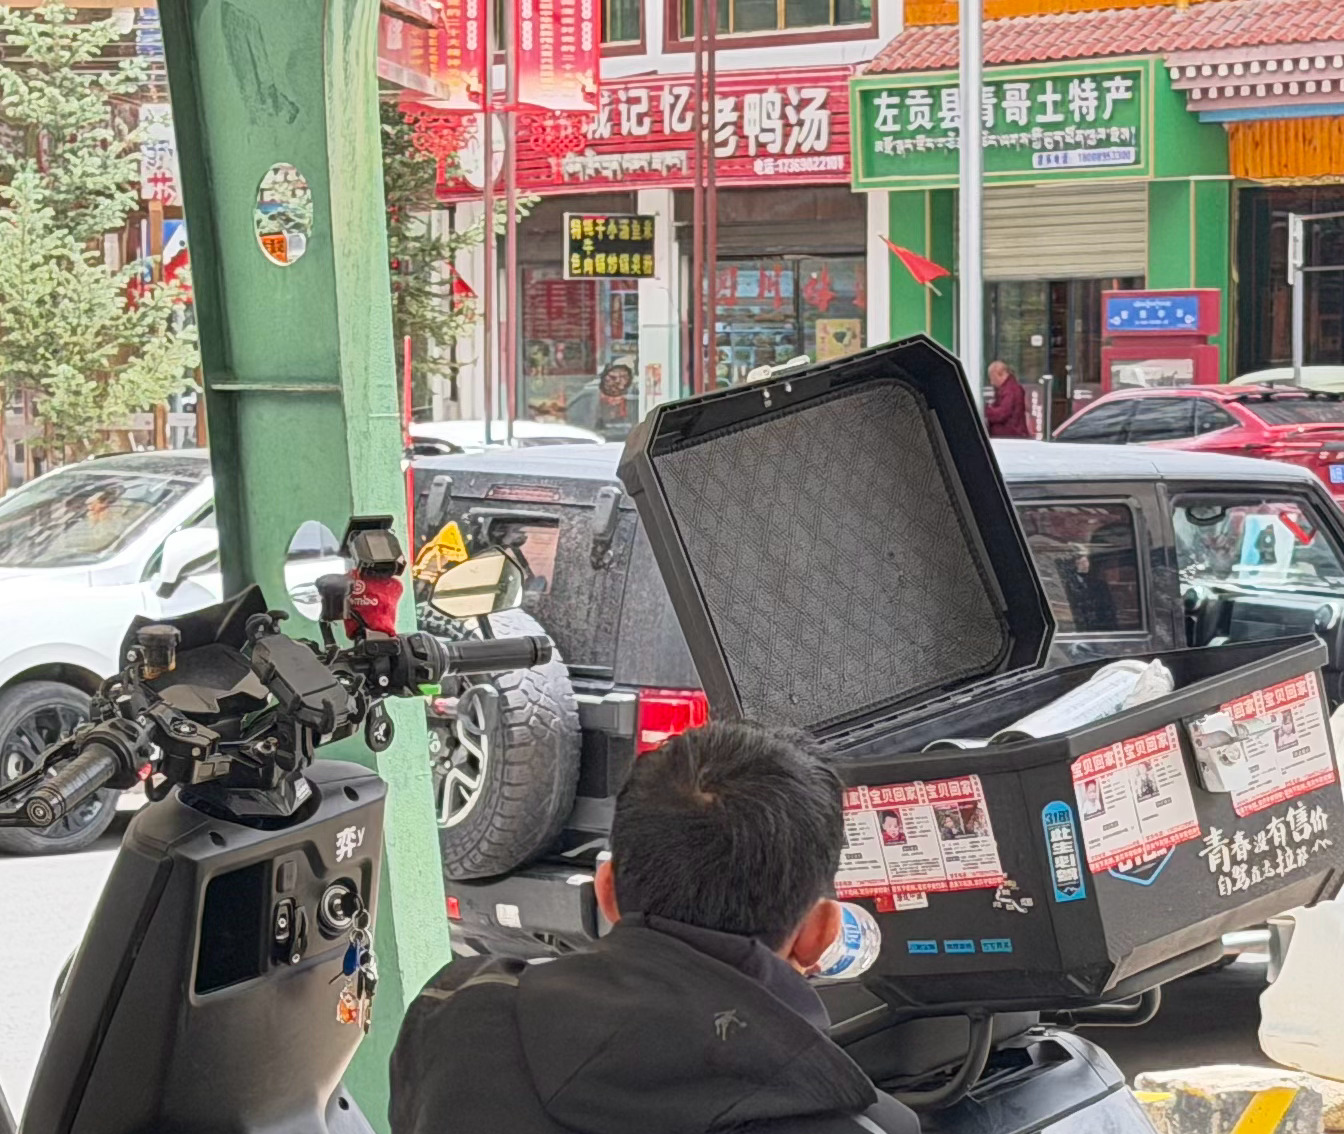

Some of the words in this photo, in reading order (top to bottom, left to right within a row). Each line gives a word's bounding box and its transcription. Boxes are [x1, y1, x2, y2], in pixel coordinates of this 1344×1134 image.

[1124, 732, 1170, 761] 宝贝回家
[869, 785, 918, 805] 宝贝回家
[926, 779, 974, 800] 宝贝回家
